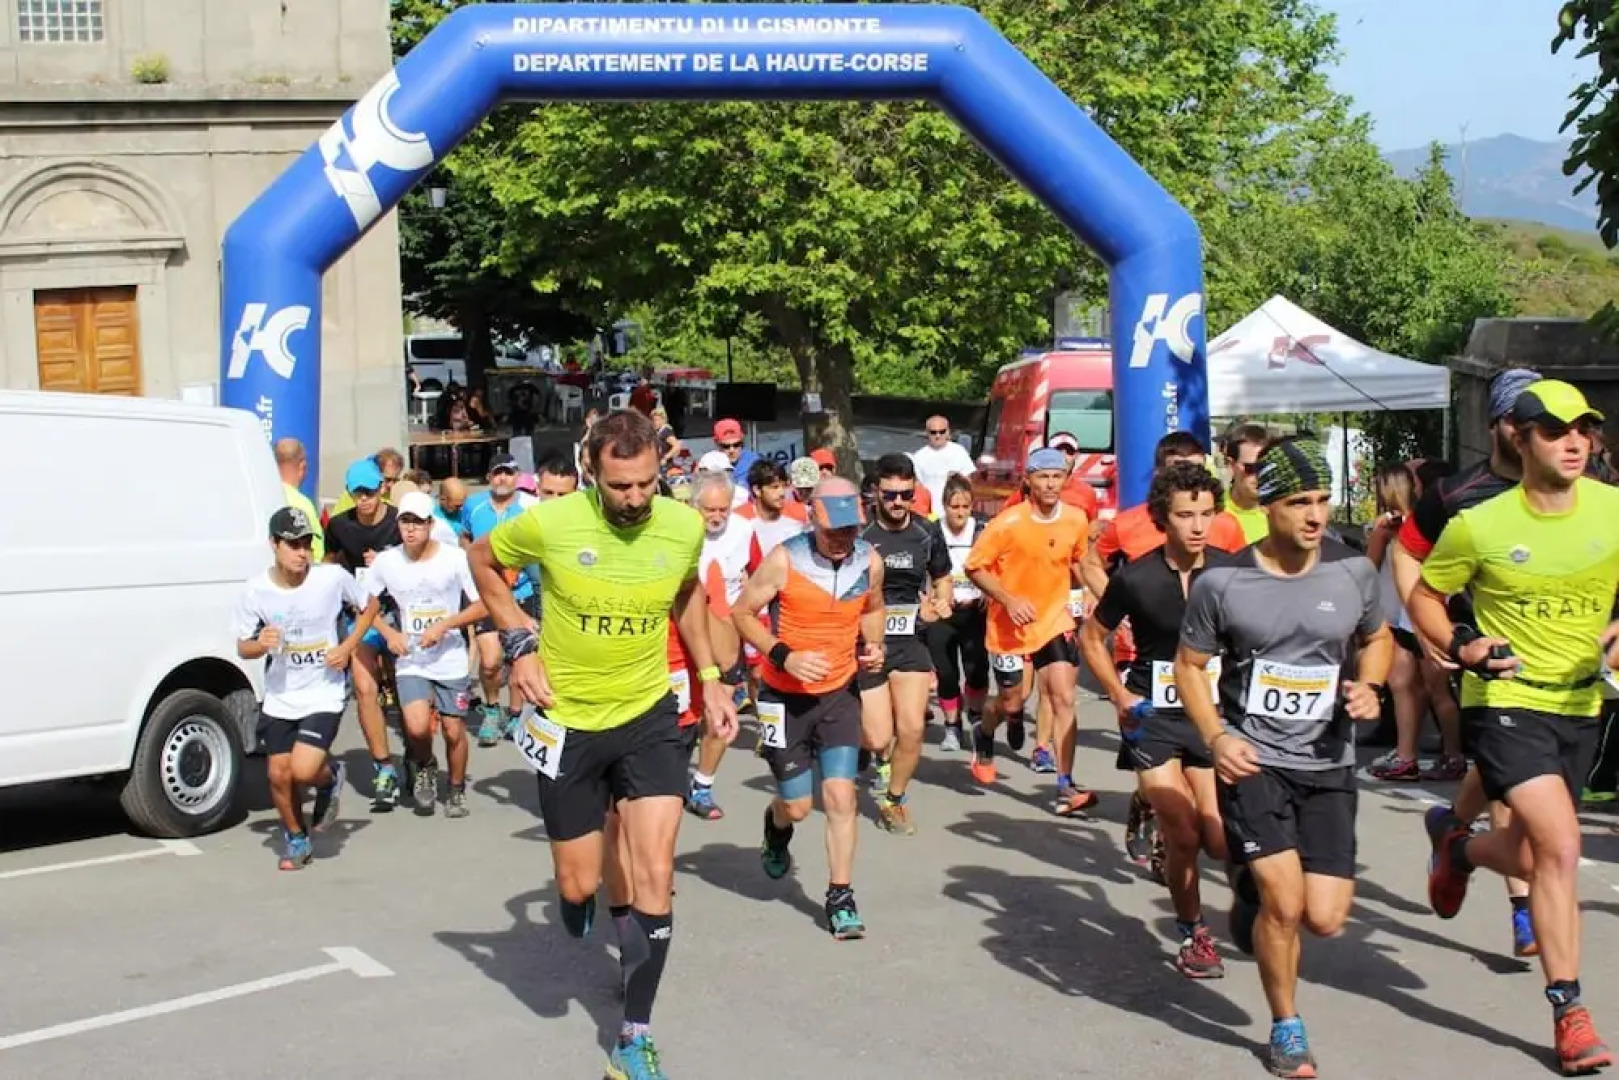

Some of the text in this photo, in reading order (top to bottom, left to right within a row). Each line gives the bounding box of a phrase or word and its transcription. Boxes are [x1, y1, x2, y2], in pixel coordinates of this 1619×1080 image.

[512, 16, 881, 34] DIPARTIMENTU DI U CISMONTE
[513, 53, 928, 72] DEPARTEMENT DE LA HAUTE-CORSE
[1514, 597, 1601, 620] TRAIL
[1263, 687, 1322, 716] 037
